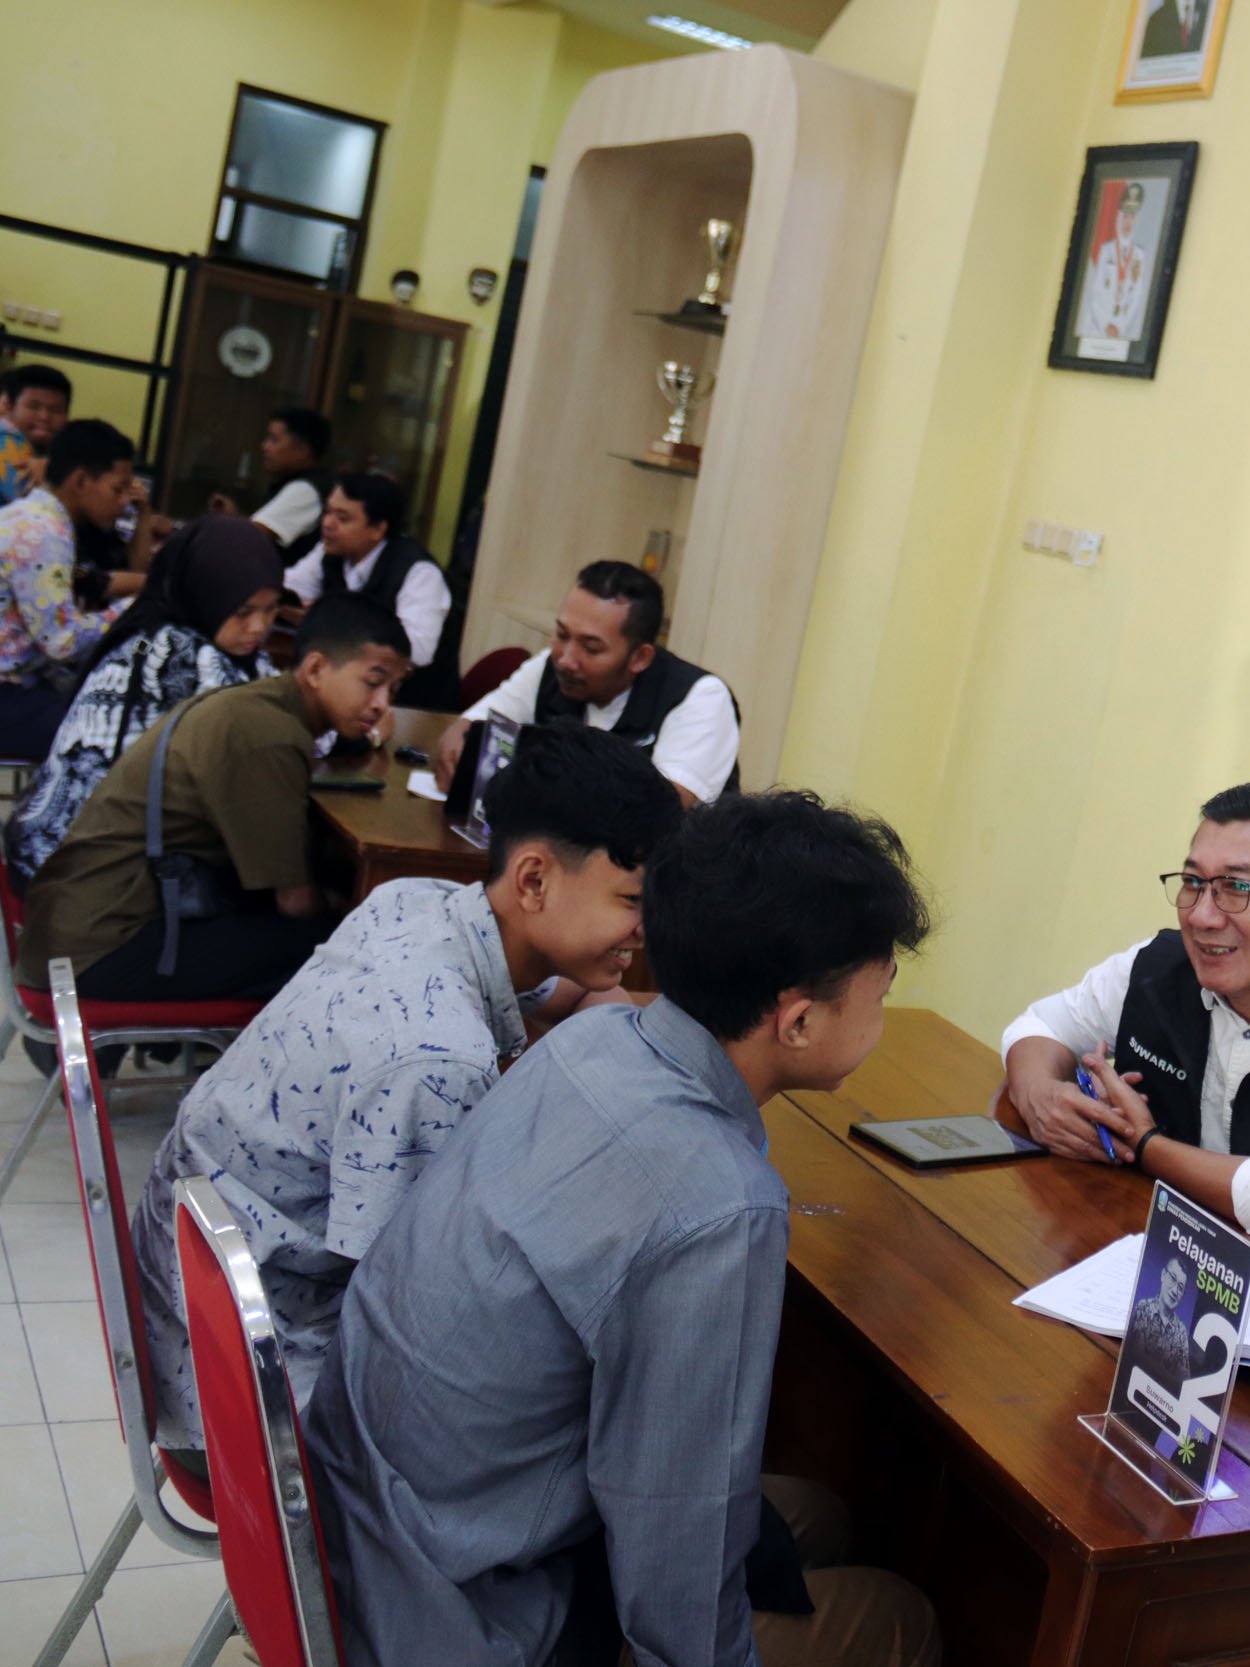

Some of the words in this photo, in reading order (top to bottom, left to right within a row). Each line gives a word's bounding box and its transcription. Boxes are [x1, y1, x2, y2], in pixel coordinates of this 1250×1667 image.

[1128, 1036, 1187, 1081] SUWARNO
[1169, 1225, 1245, 1294] Pelayanan
[1196, 1270, 1241, 1315] SPMB
[1180, 1312, 1239, 1435] 2
[1145, 1384, 1174, 1413] Suwarno
